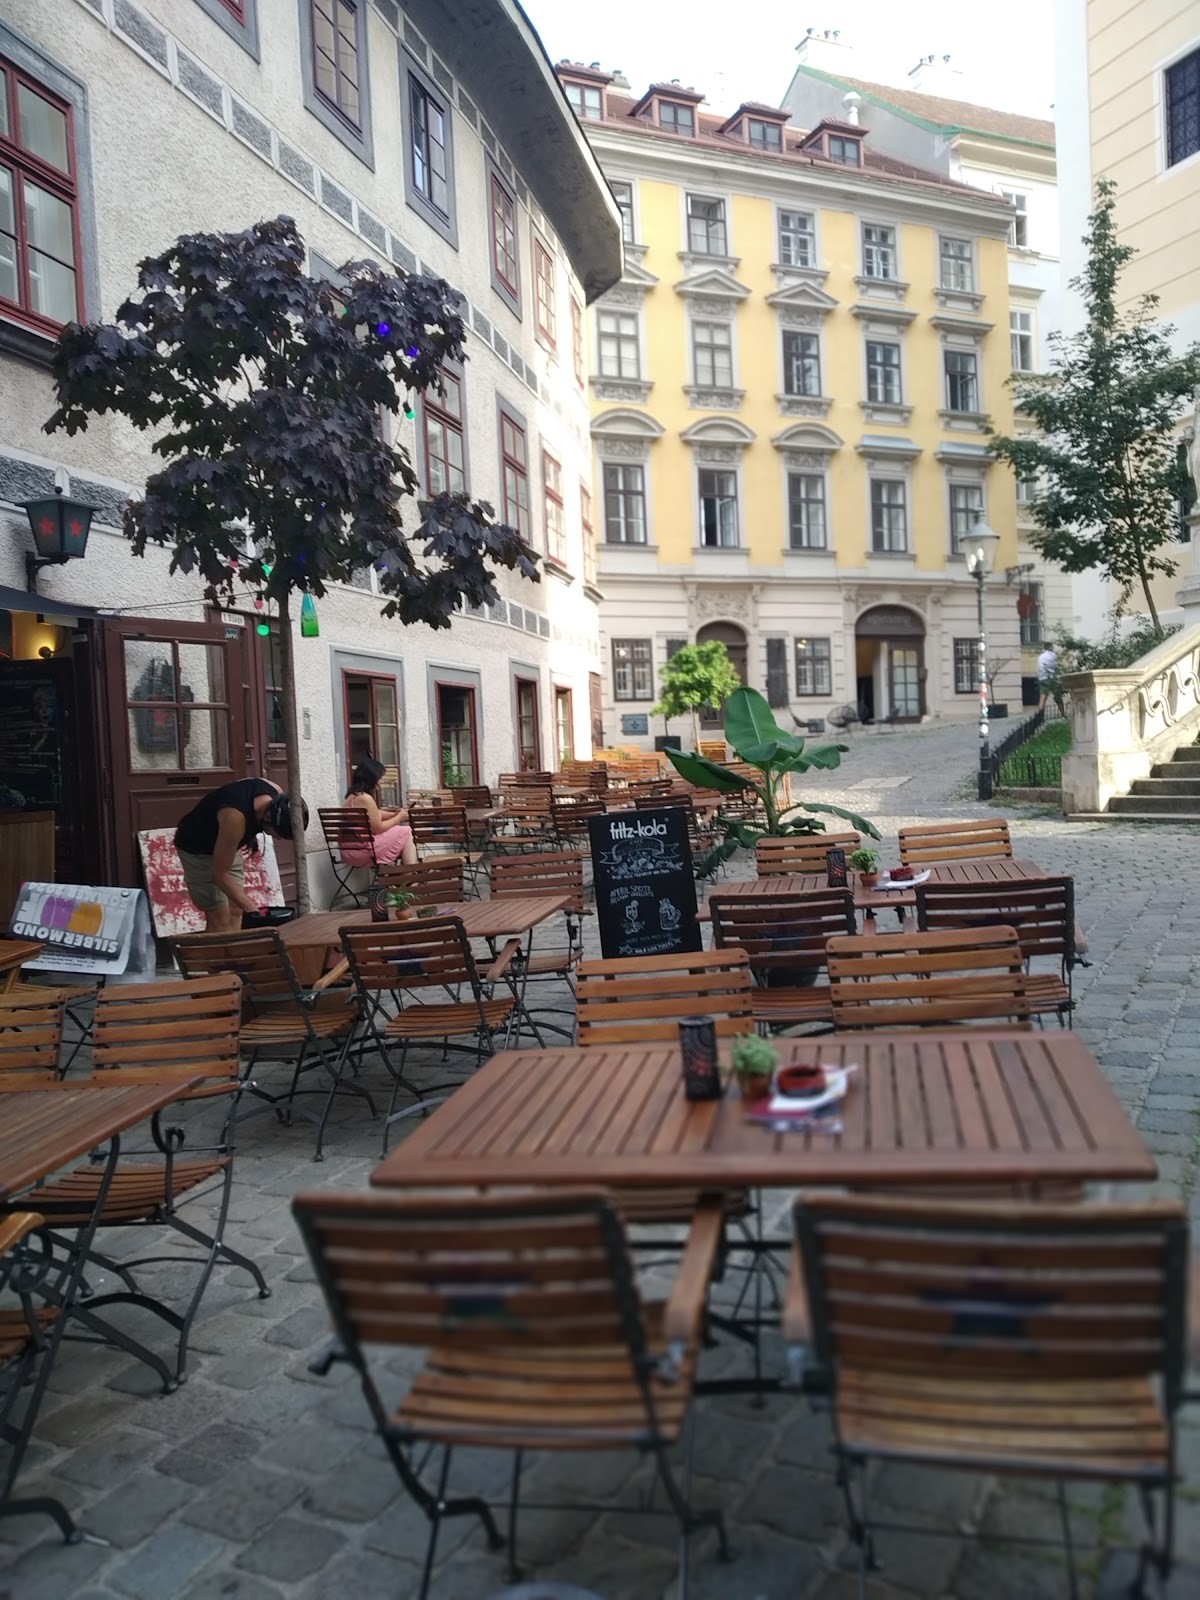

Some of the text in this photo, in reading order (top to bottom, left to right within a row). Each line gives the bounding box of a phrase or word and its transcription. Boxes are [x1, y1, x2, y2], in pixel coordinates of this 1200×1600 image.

[610, 819, 667, 840] fritz-kola
[28, 881, 128, 909] SOMMER 2024
[13, 922, 119, 954] SILBERMOND
